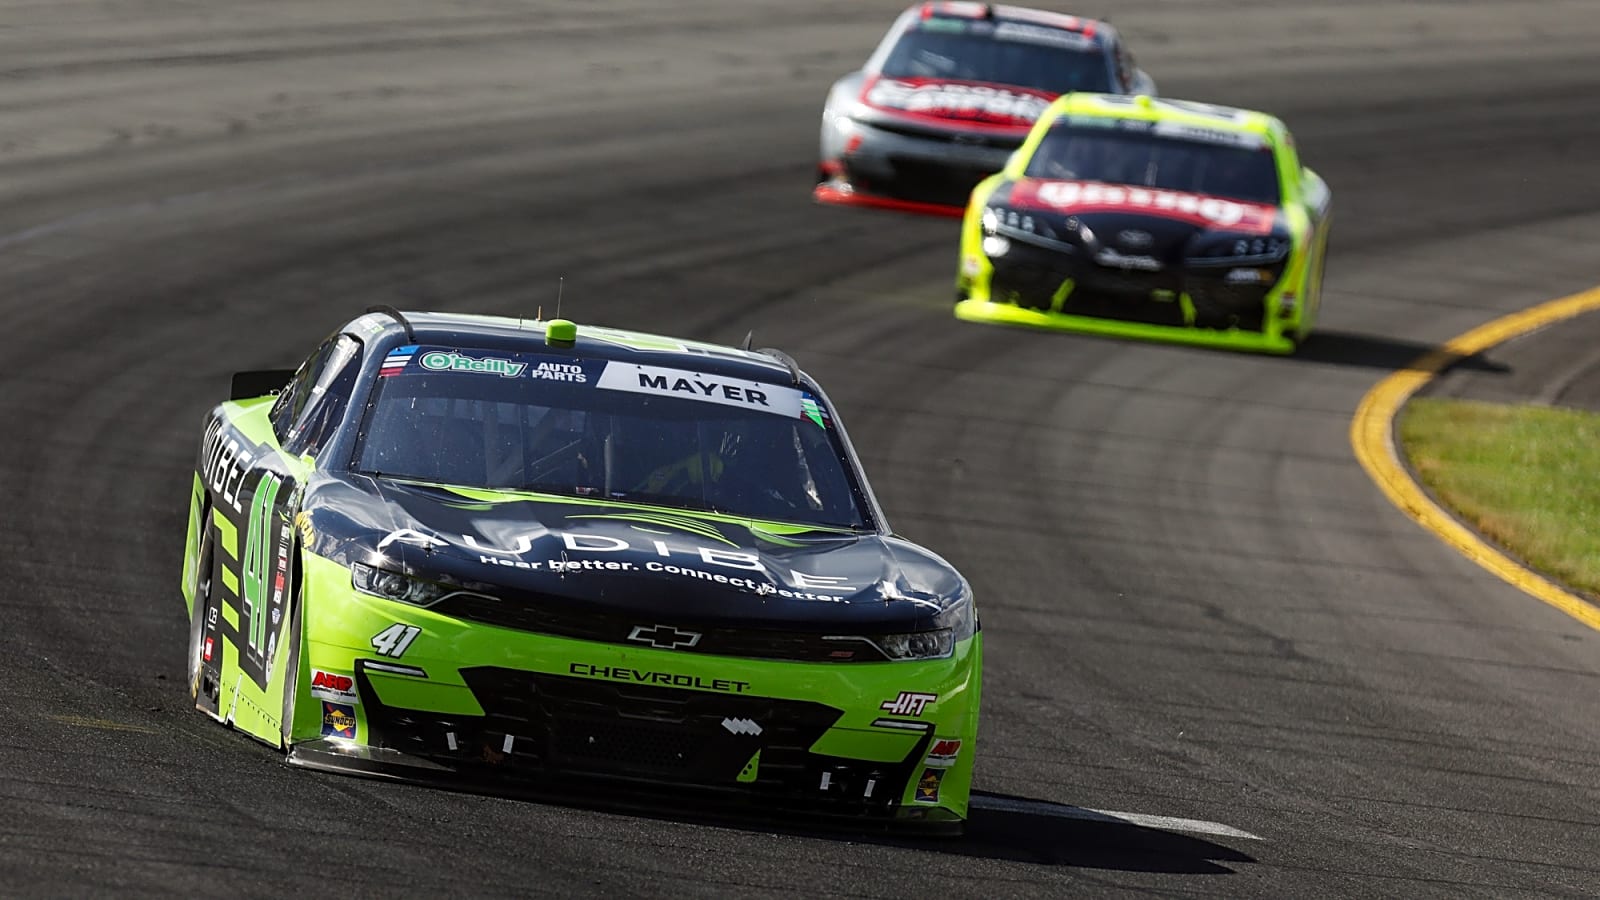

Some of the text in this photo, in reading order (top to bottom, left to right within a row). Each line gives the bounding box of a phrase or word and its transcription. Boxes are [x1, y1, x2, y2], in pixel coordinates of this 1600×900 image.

[423, 352, 523, 376] O'Reilly
[532, 369, 587, 383] PARTS
[536, 362, 582, 375] AUTO
[638, 373, 770, 406] MAYER
[243, 470, 281, 657] 41
[479, 555, 542, 570] Hear
[549, 559, 640, 571] better.
[646, 562, 756, 590] Connect
[371, 623, 422, 659] 41
[312, 671, 353, 691] ARP
[569, 663, 750, 692] CHEVROLET
[325, 714, 355, 727] SUNOCO
